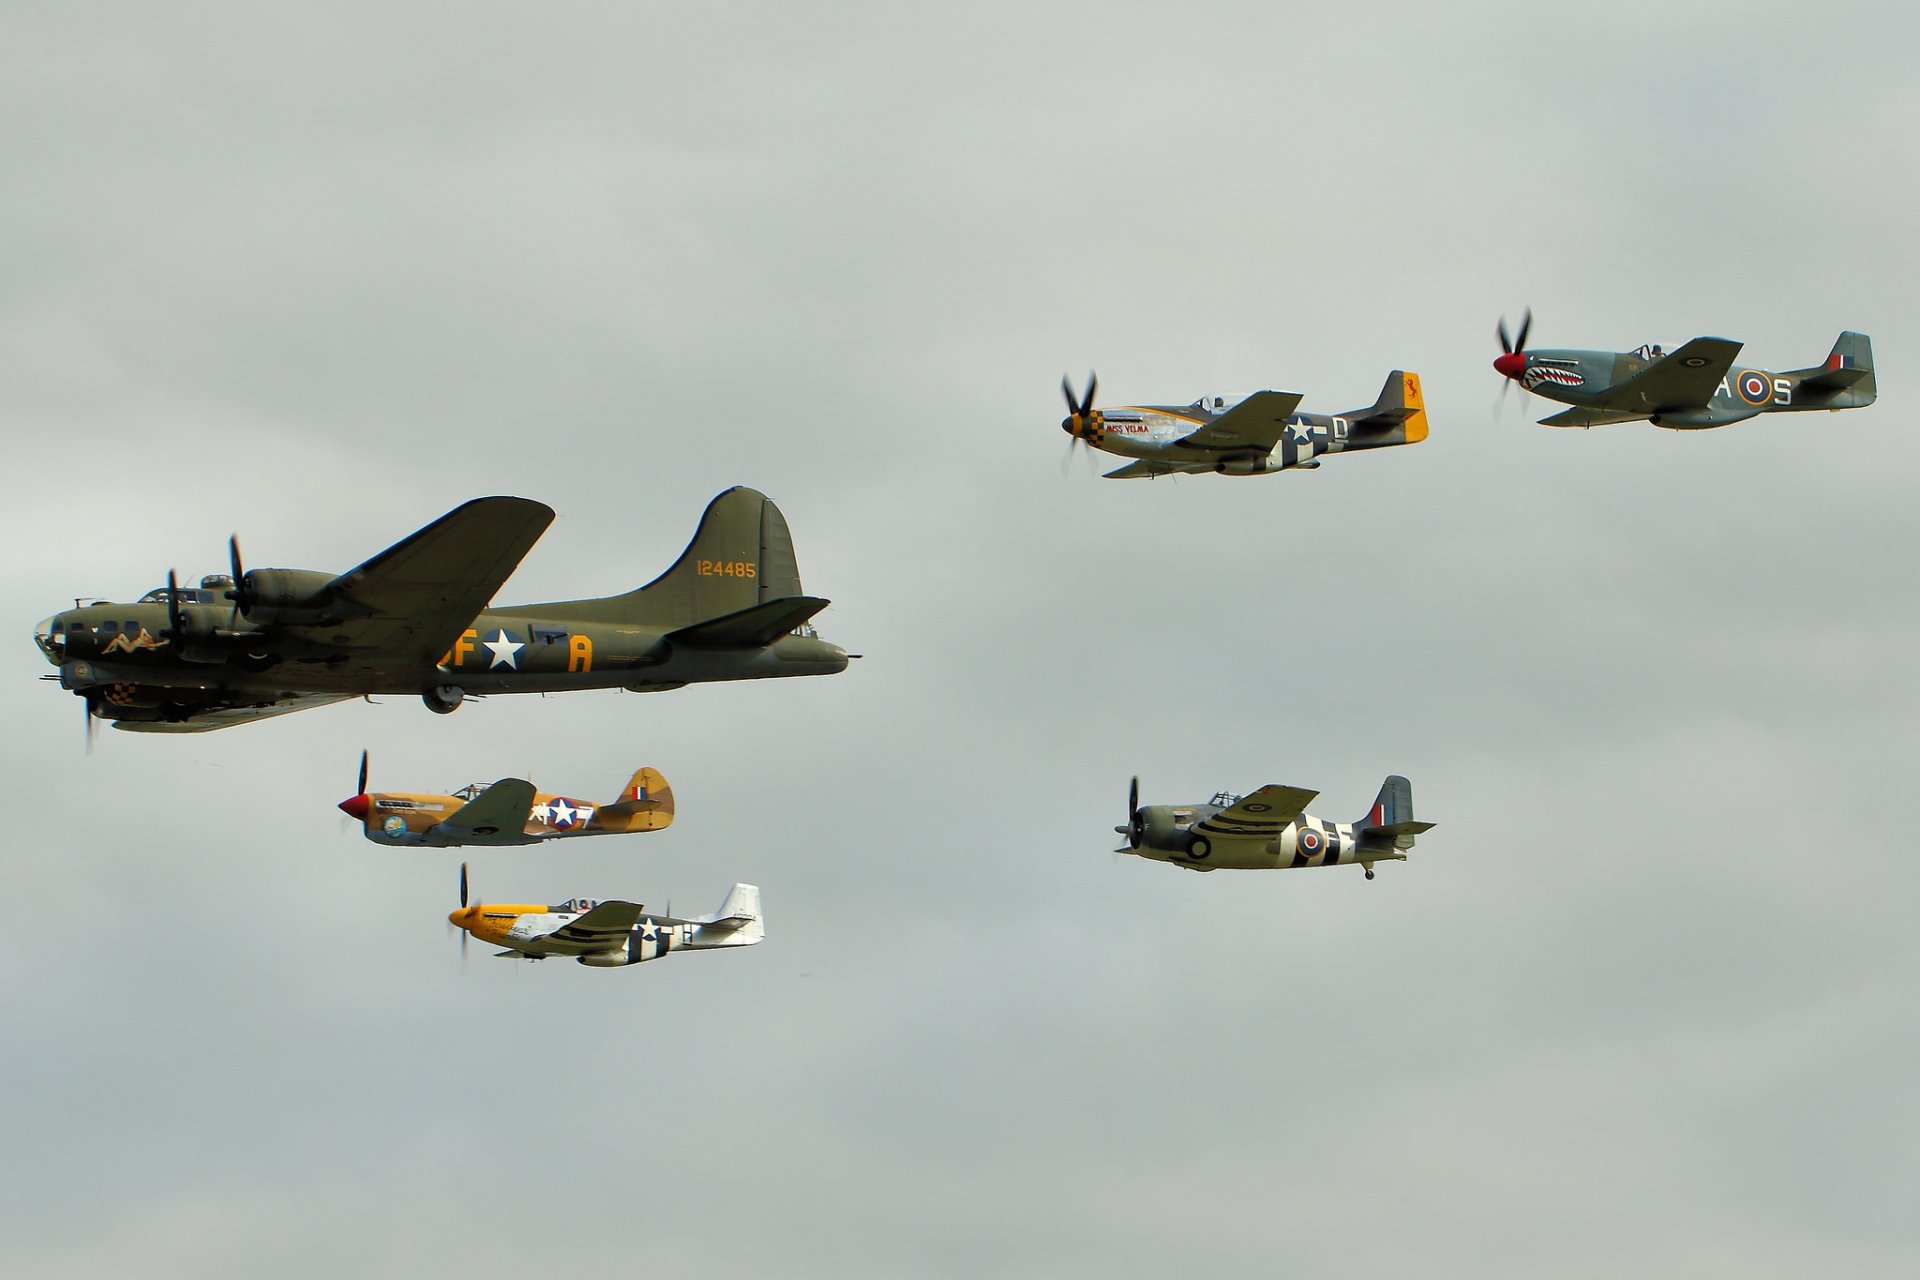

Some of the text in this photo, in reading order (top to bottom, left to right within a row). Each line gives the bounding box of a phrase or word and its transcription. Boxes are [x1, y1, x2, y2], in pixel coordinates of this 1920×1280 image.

[1714, 376, 1792, 405] A S
[1106, 424, 1149, 433] MISS VELMA
[1332, 417, 1348, 438] D
[697, 560, 756, 578] 124485
[437, 629, 593, 672] F A
